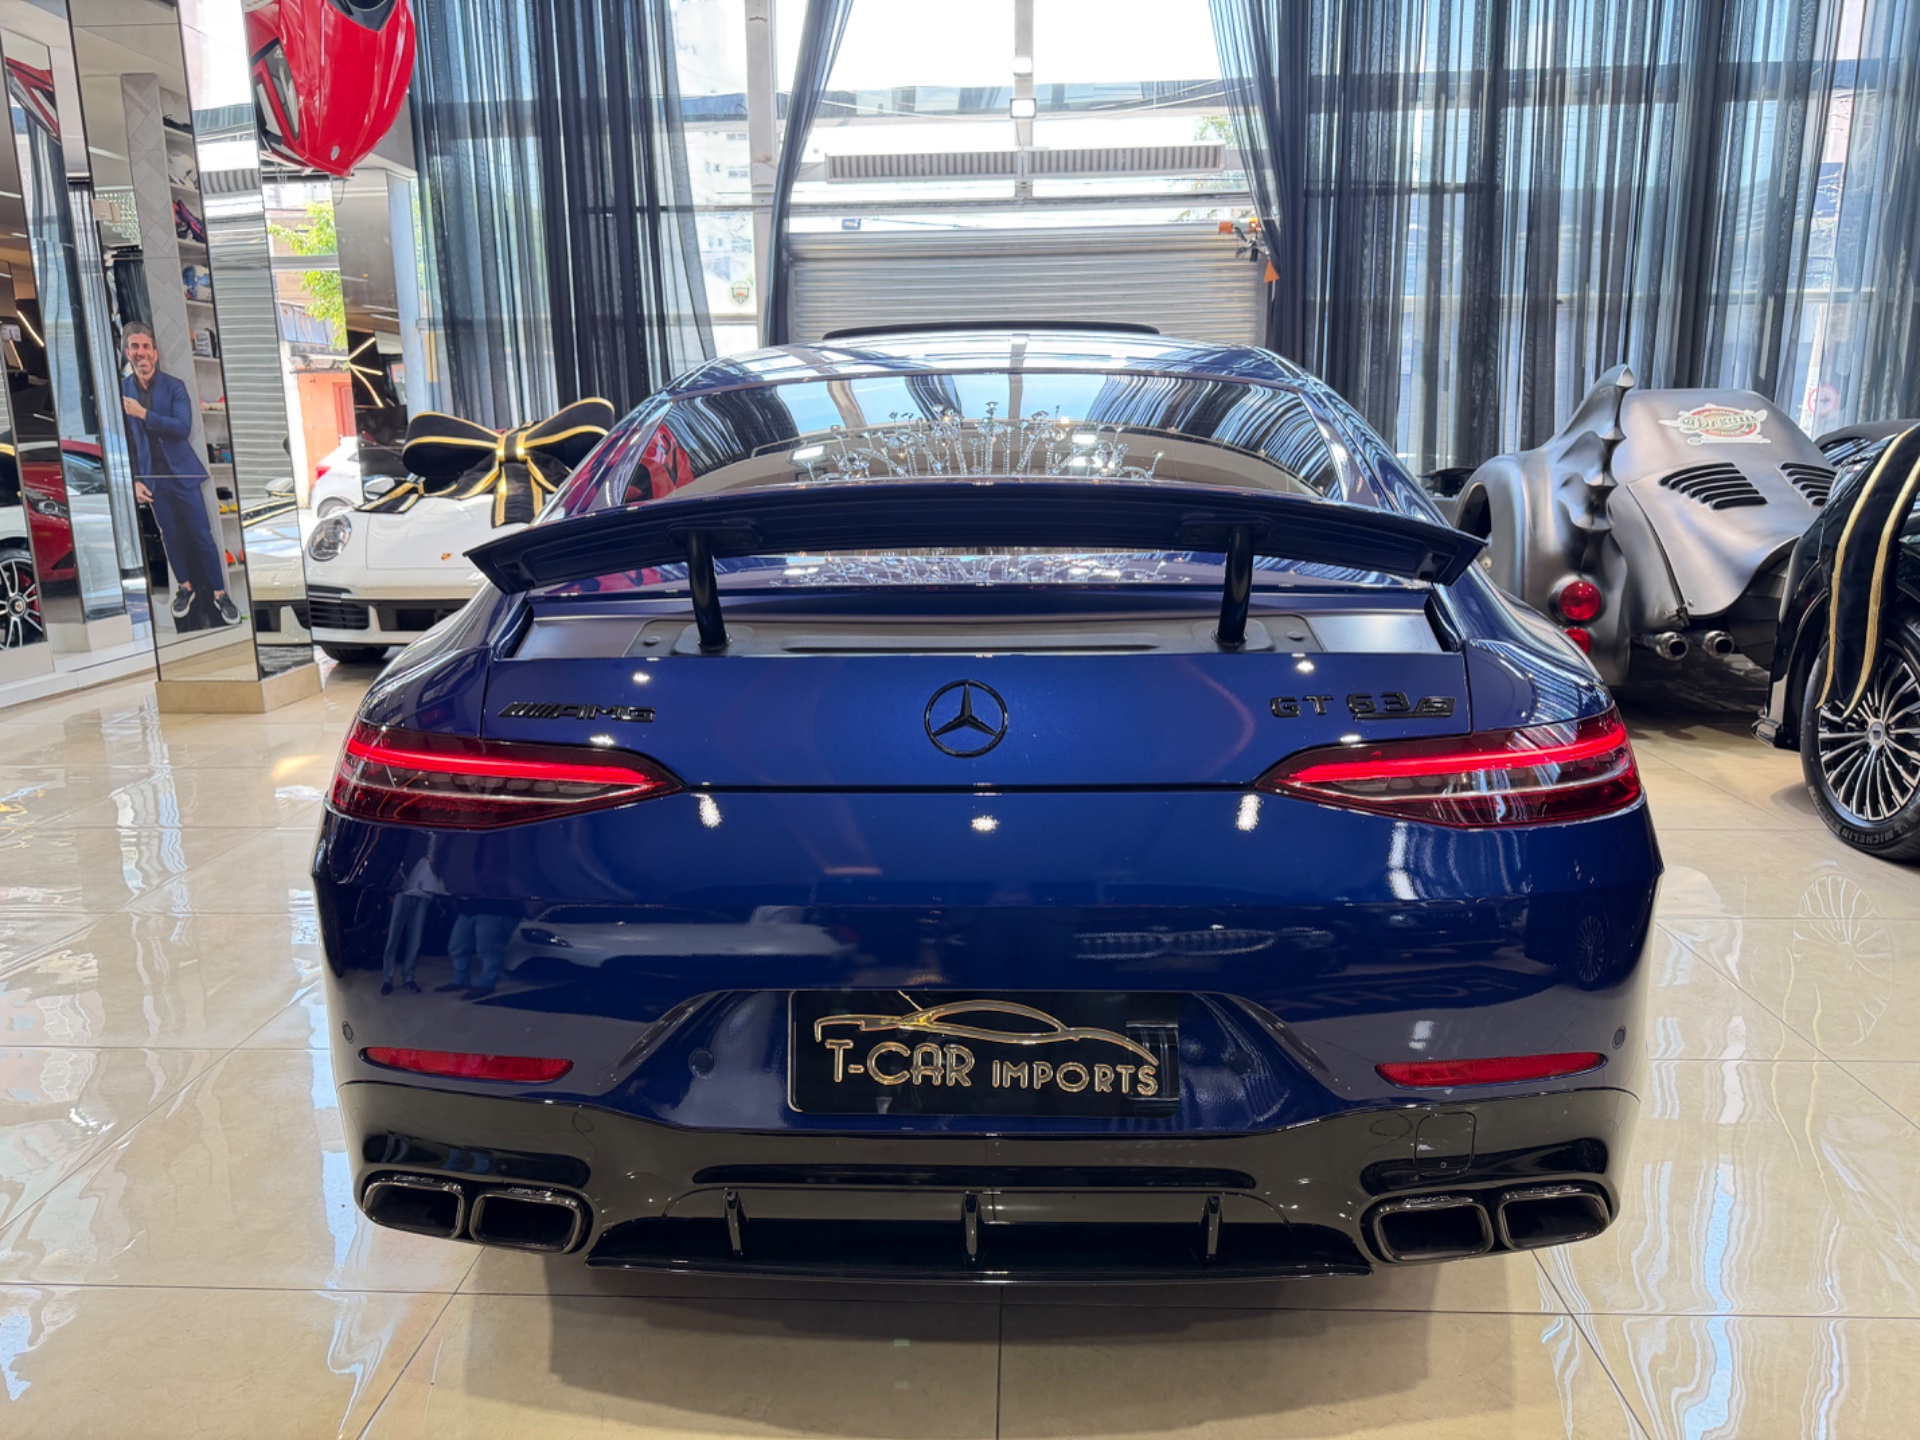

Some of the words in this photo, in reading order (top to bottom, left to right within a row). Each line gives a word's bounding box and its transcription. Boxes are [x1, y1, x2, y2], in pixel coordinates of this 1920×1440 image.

[549, 703, 657, 723] AMG
[1270, 695, 1334, 718] GT
[1840, 826, 1894, 845] MICHELIN
[825, 1039, 975, 1087] T-CAR
[991, 1059, 1159, 1096] IMPORTS
